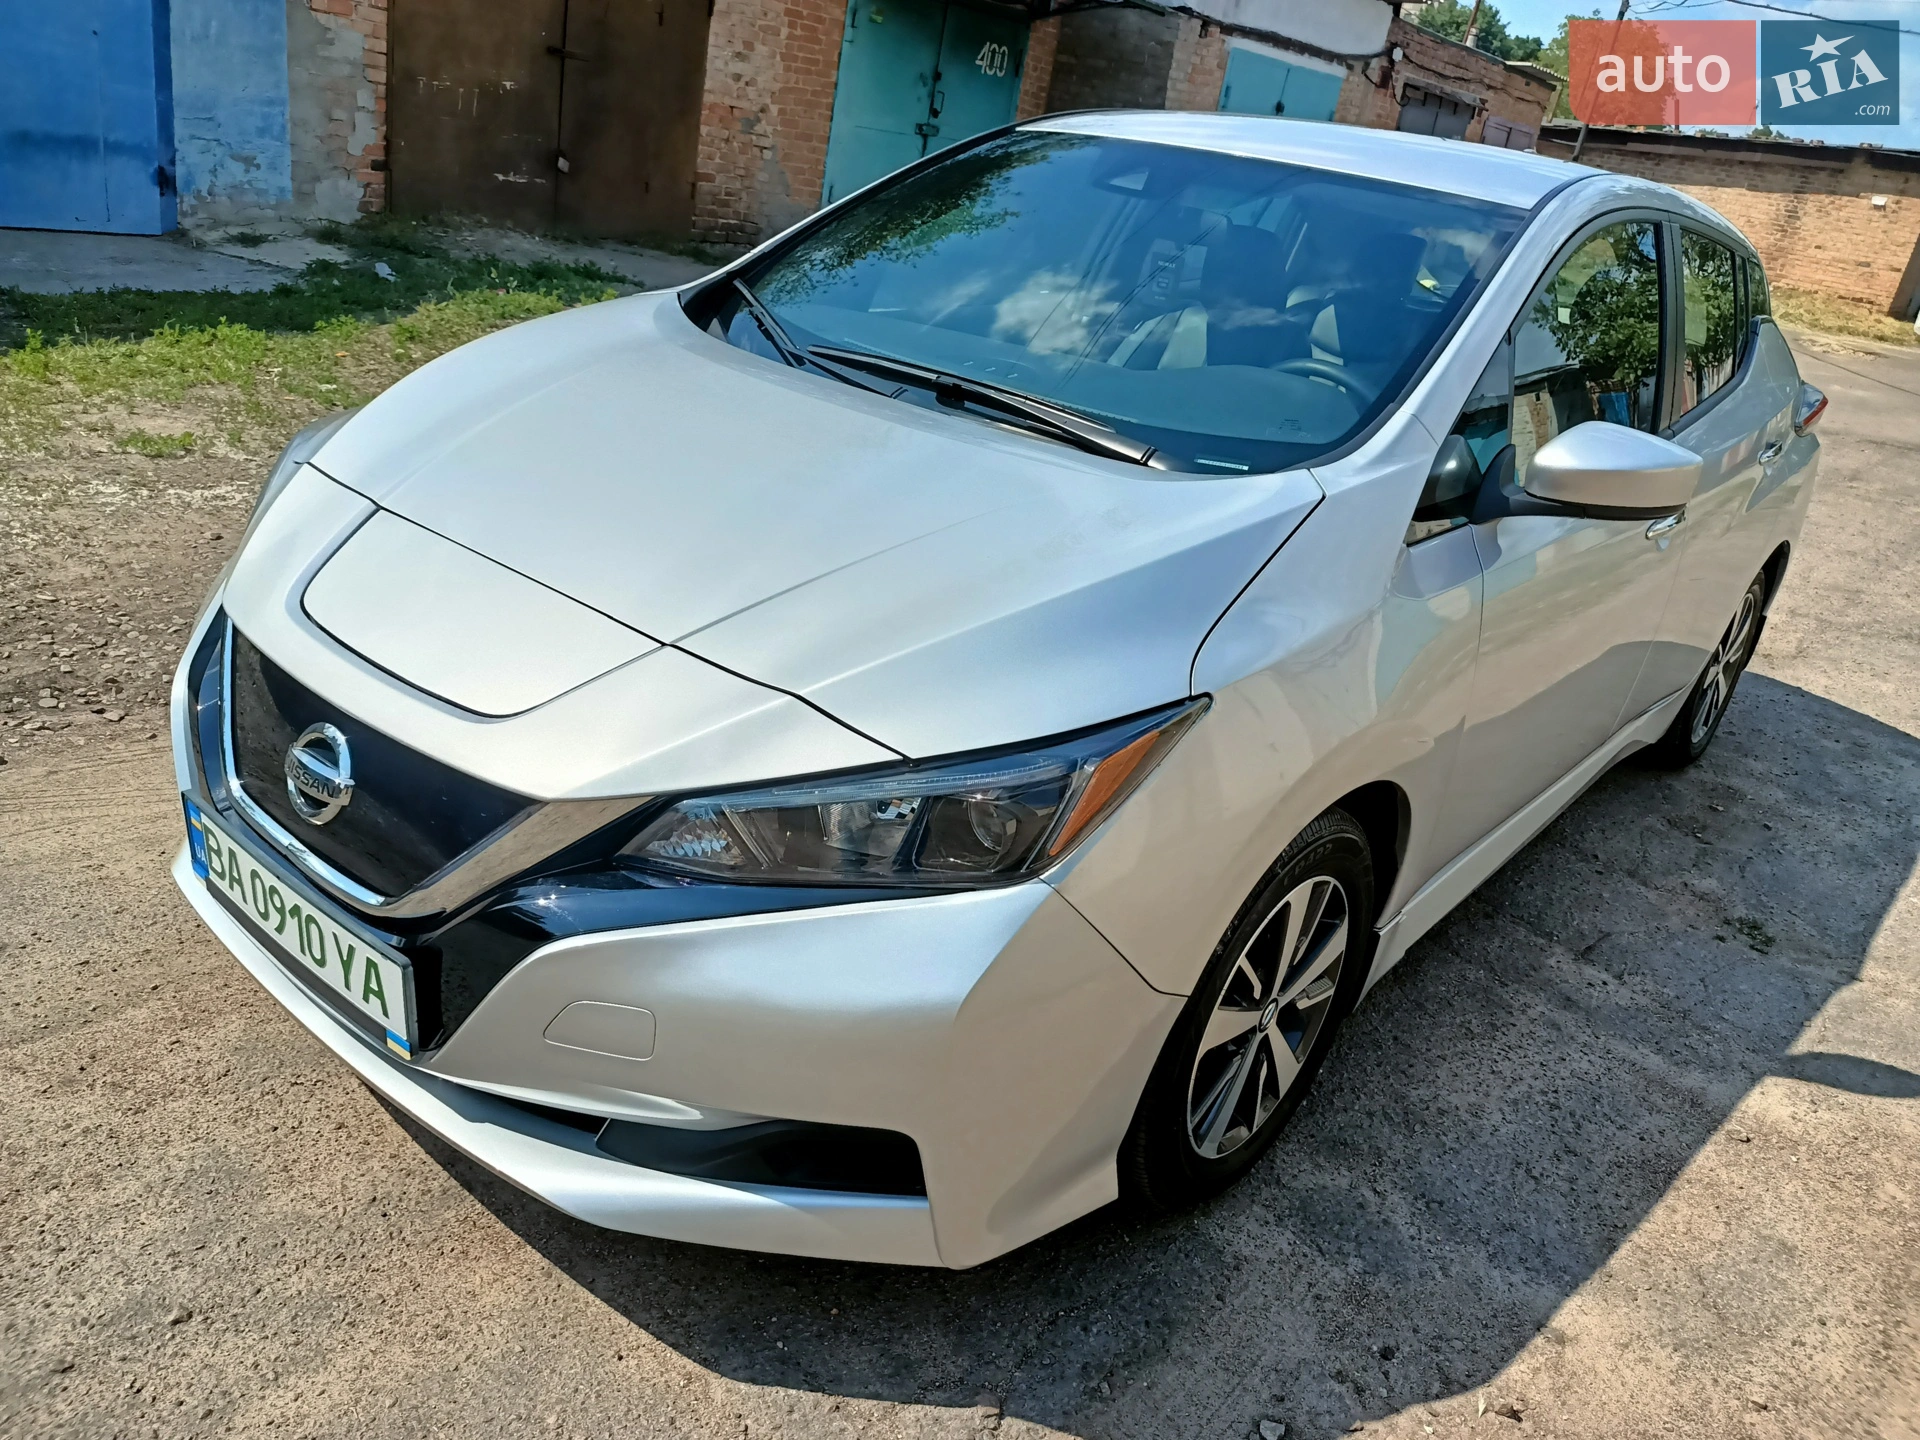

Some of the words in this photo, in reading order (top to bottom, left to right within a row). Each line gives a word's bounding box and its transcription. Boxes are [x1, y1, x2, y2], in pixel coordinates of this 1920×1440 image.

[975, 42, 1008, 77] 400
[195, 843, 207, 865] UA
[203, 822, 247, 905] BA
[250, 868, 326, 969] 0910
[332, 931, 390, 1020] YA
